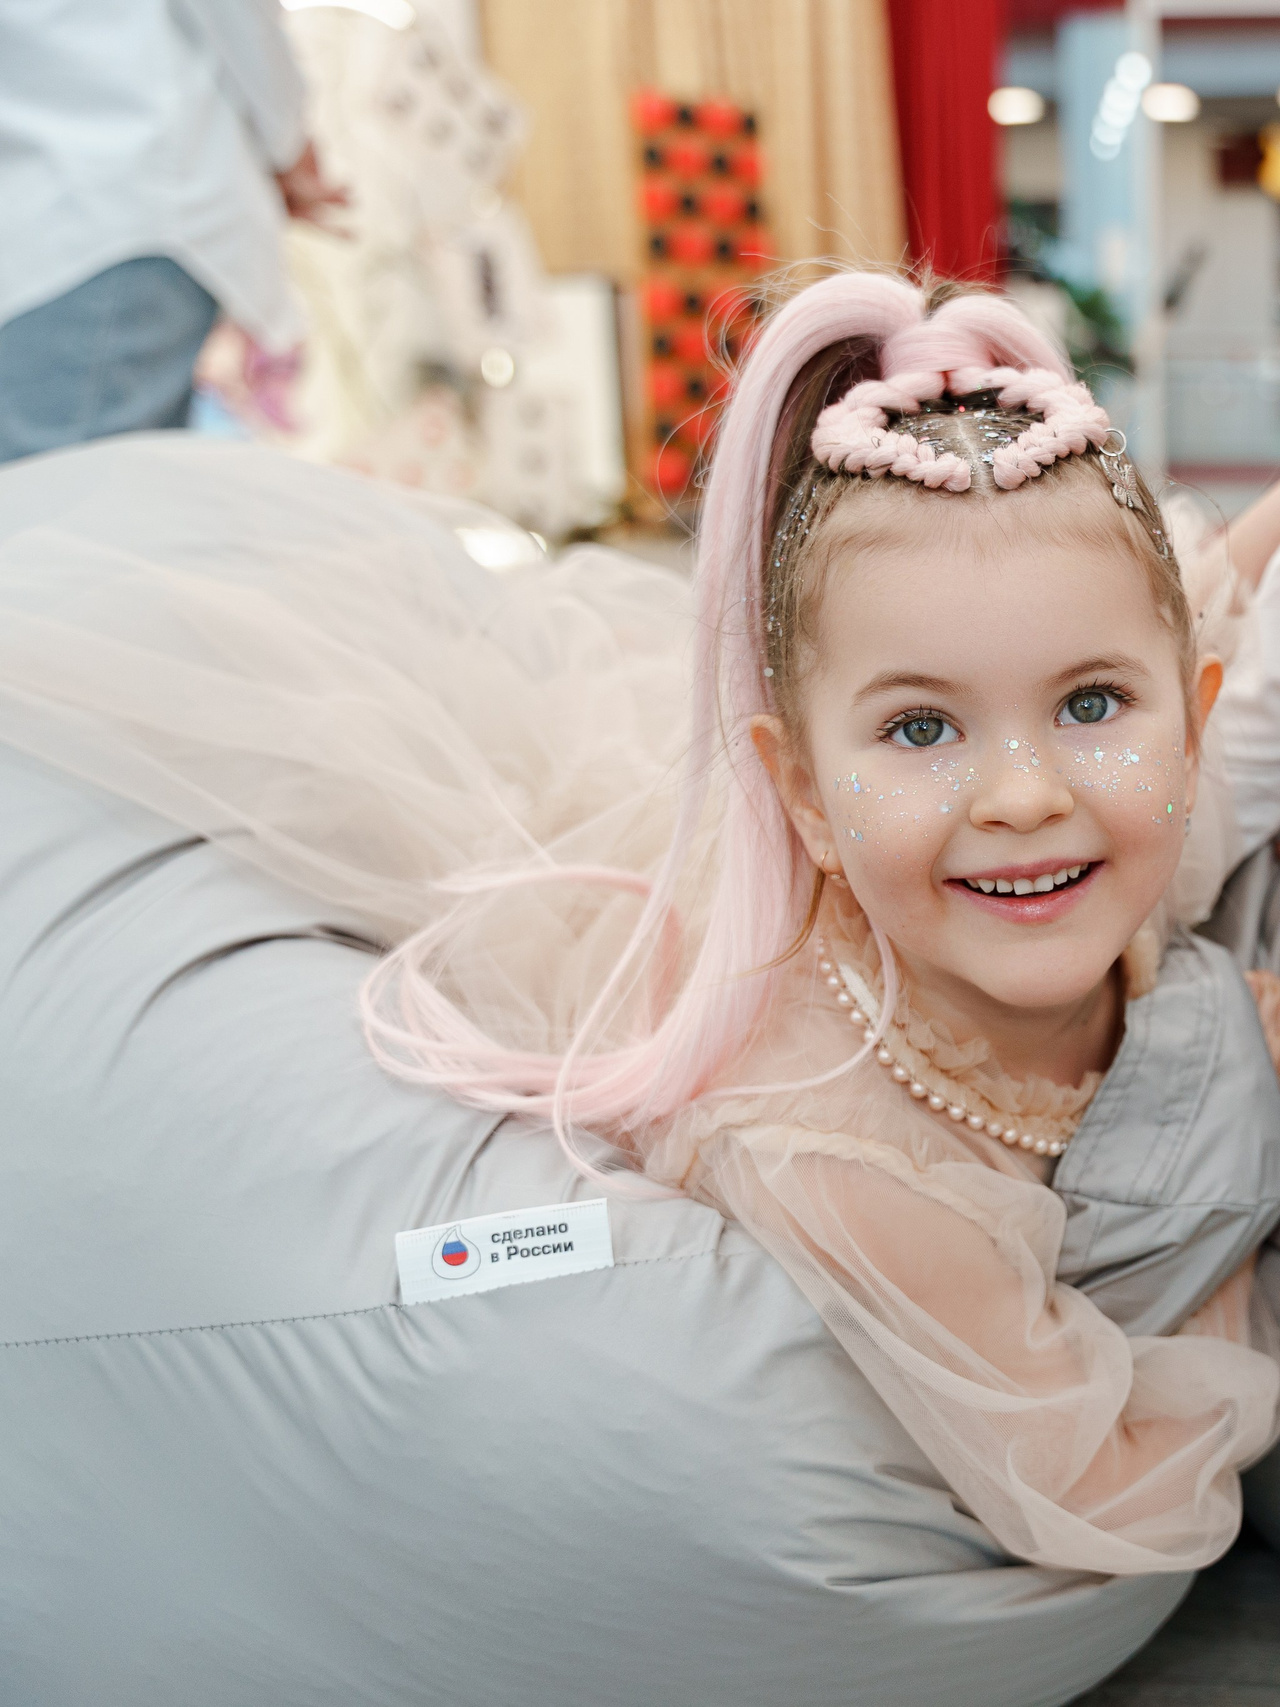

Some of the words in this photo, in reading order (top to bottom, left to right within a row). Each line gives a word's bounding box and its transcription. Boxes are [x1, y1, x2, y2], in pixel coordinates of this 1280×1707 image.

[491, 1222, 568, 1244] сделано
[490, 1252, 499, 1263] в
[507, 1241, 574, 1260] России
